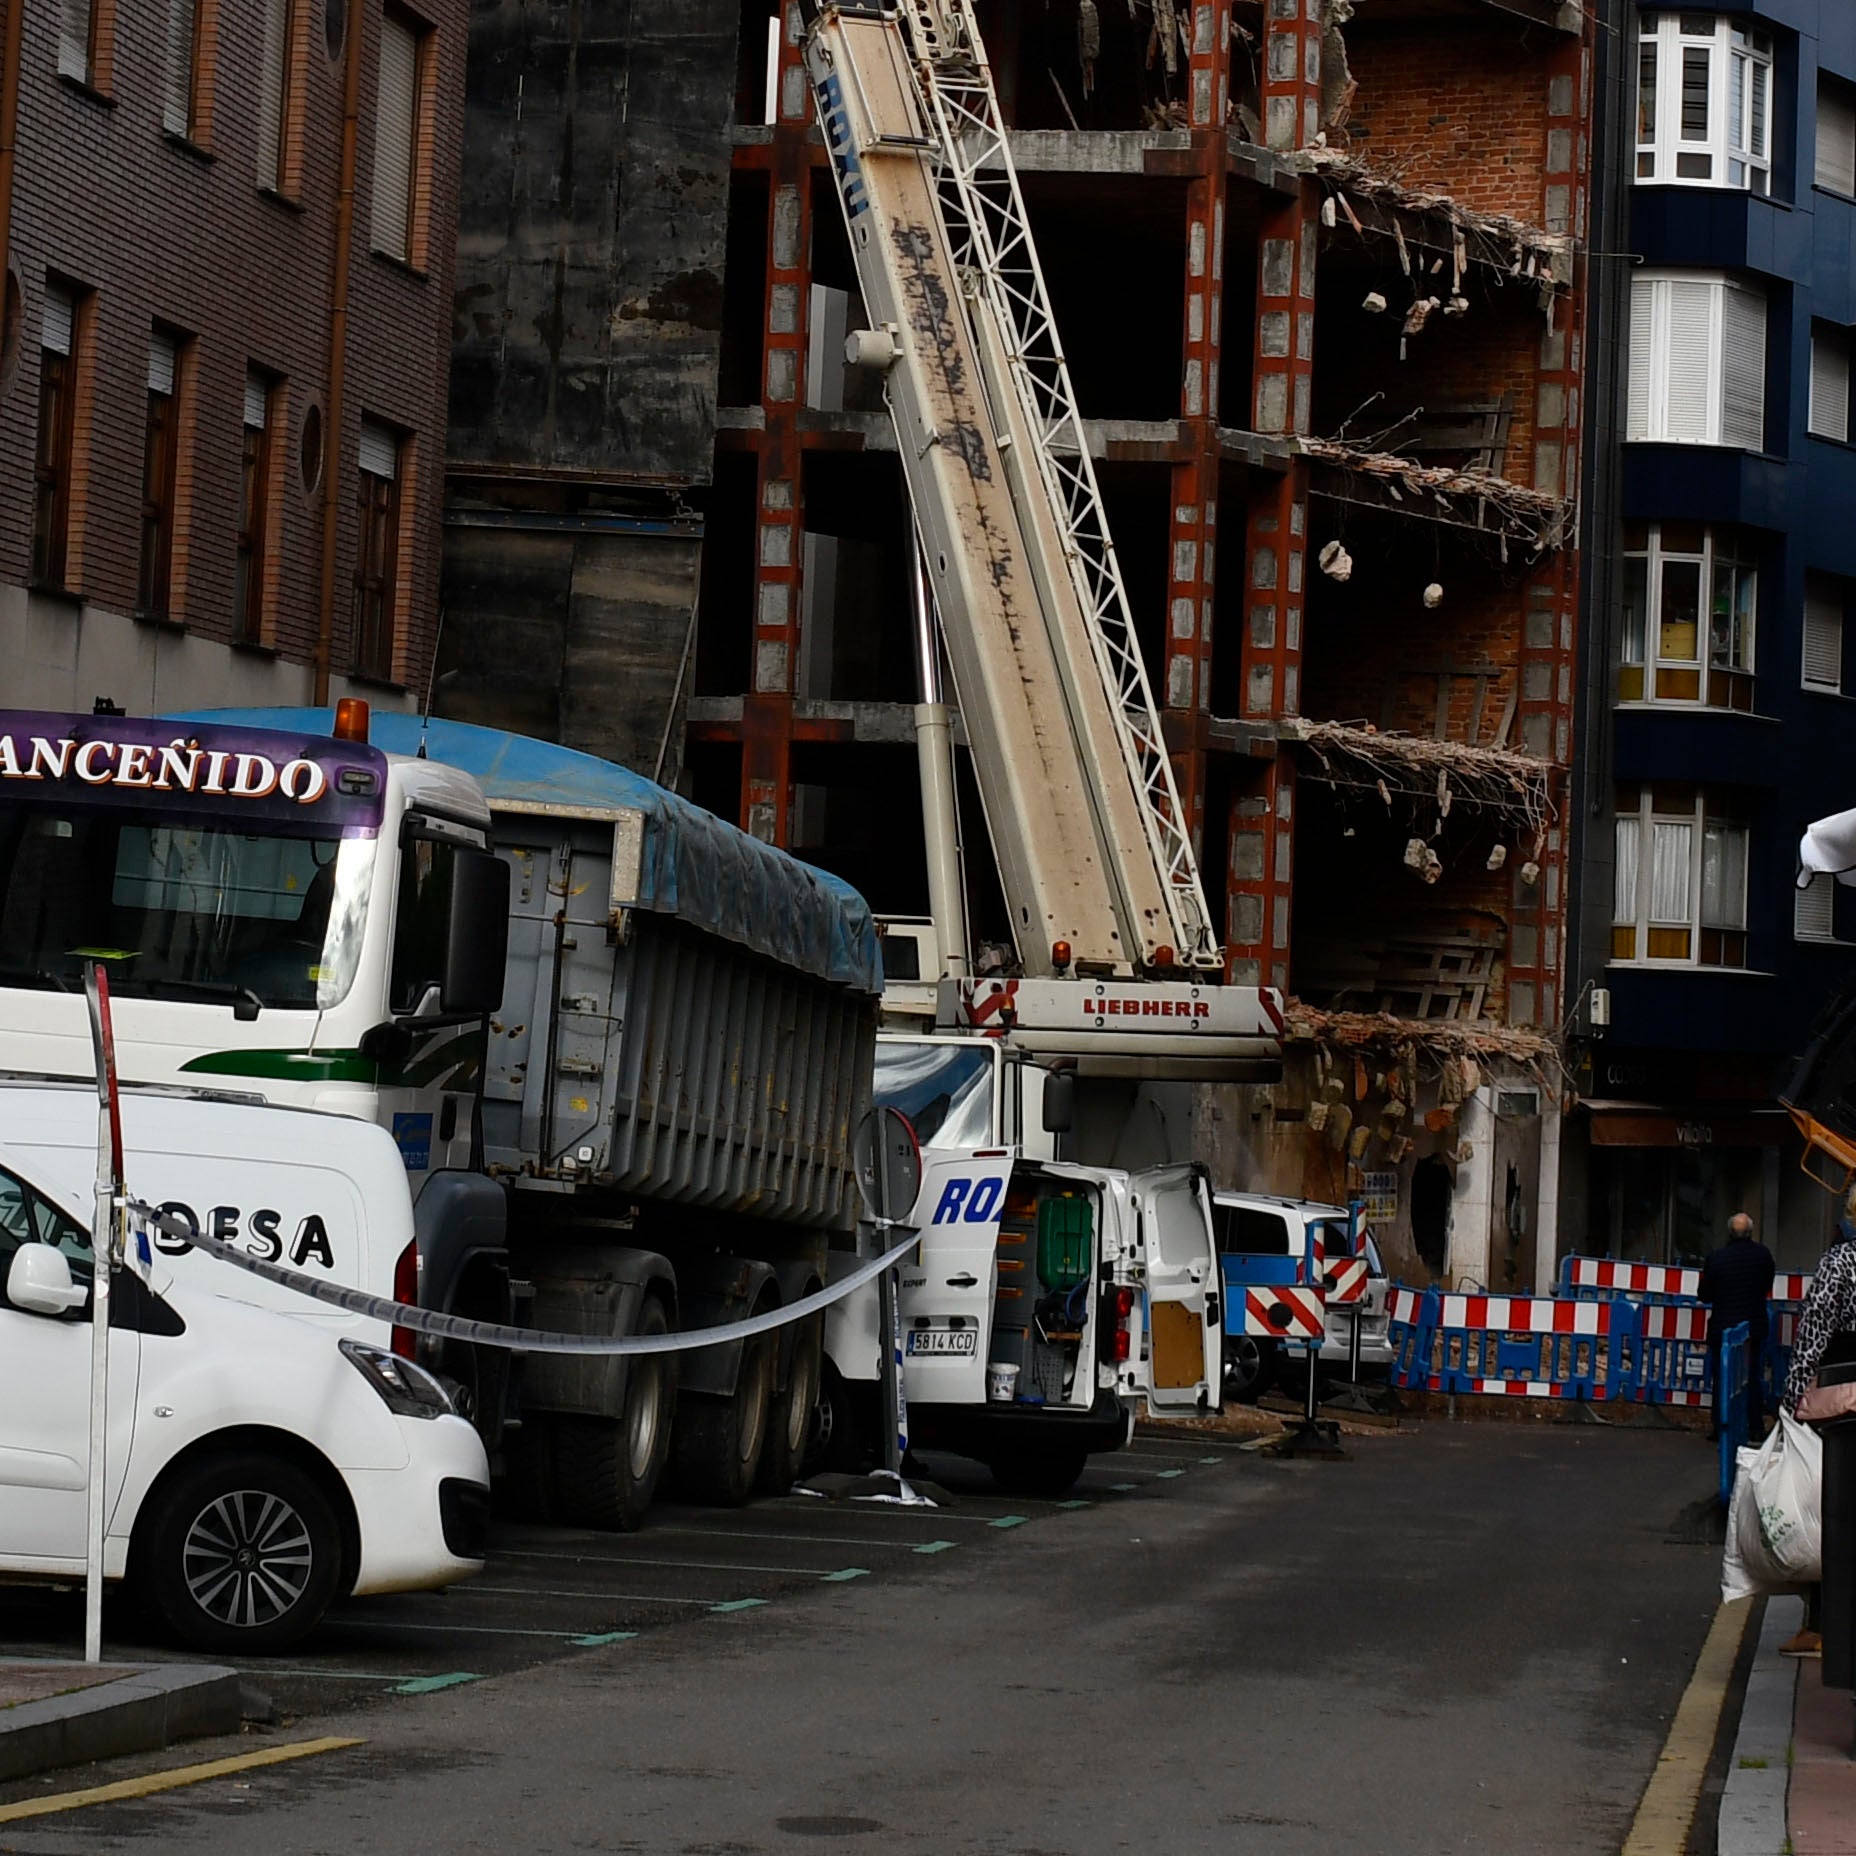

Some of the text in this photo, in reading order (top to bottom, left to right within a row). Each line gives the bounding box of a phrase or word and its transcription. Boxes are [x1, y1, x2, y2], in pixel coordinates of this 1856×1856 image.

[817, 73, 869, 219] ROXU
[1083, 998, 1210, 1018] LIEBHERR
[931, 1176, 1005, 1225] RO
[915, 1333, 973, 1350] 5814 KCD
